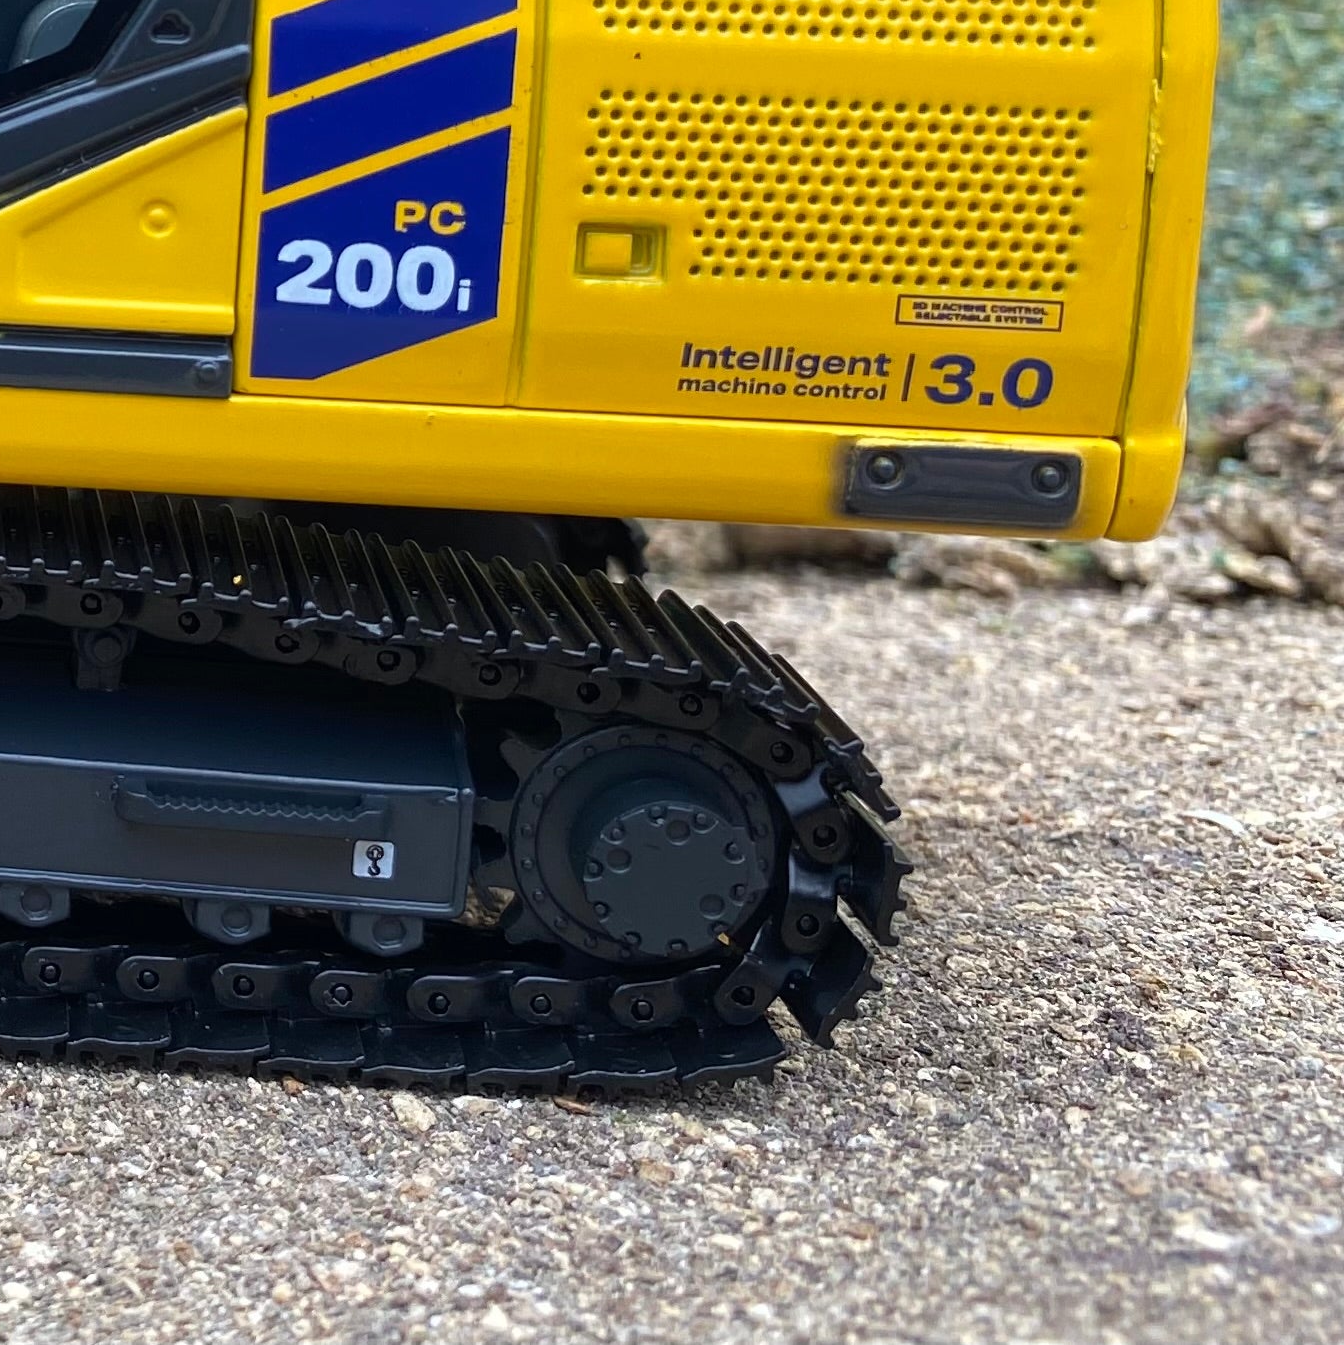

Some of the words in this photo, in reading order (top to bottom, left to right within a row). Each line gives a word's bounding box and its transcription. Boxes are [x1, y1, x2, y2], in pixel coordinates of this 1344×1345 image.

[394, 200, 466, 235] PC
[991, 305, 1048, 316] CONTROL
[681, 342, 892, 379] Intelligent
[677, 376, 787, 396] machine
[793, 381, 886, 401] control
[924, 354, 1054, 409] 3.0
